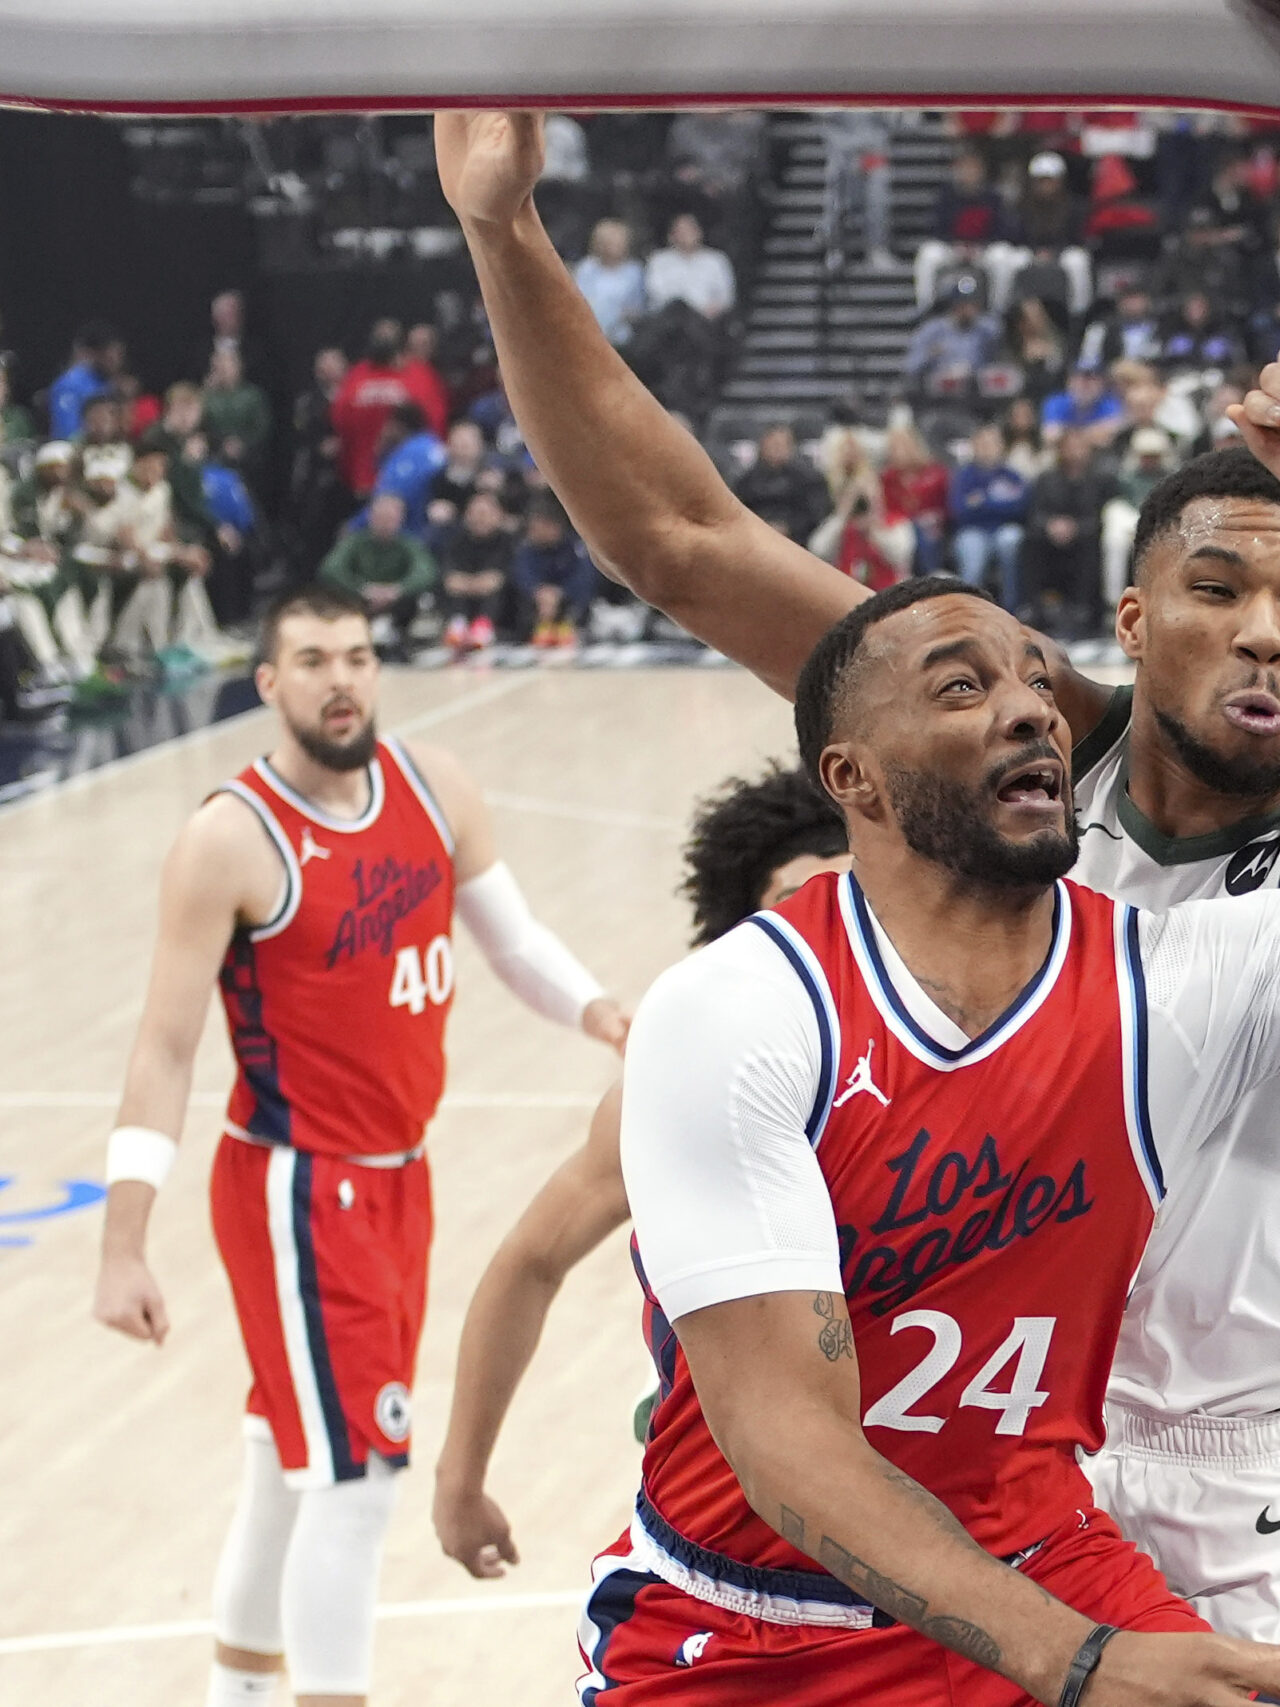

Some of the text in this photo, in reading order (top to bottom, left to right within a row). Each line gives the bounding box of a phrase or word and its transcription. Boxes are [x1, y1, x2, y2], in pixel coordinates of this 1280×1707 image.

[353, 855, 408, 908] Los
[388, 934, 453, 1015] 40
[869, 1127, 1013, 1236] Los
[861, 1309, 1057, 1436] 24
